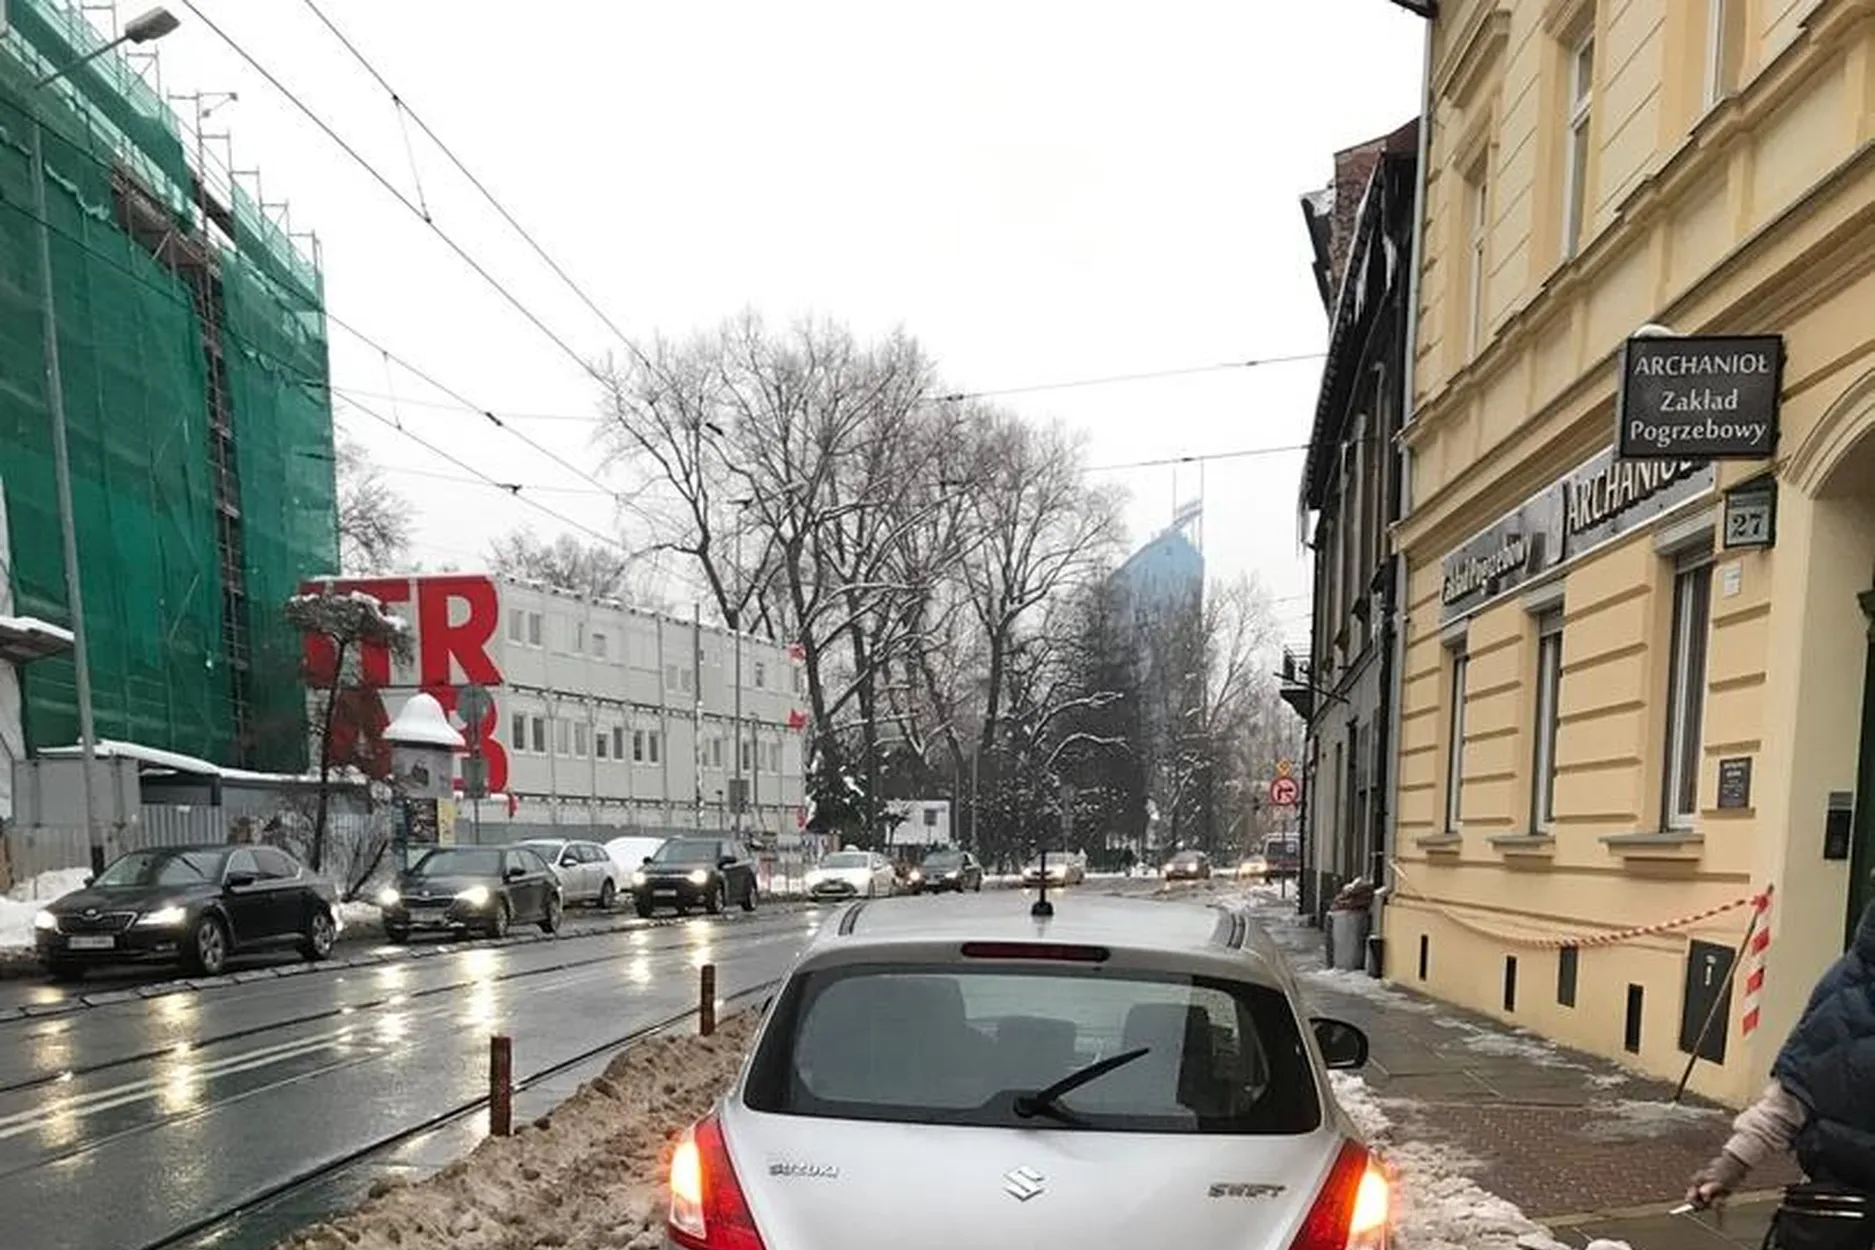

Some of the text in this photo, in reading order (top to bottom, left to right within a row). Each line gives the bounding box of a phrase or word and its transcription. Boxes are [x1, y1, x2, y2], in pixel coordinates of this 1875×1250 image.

[1634, 353, 1769, 376] ARCHANIOŁ
[1660, 387, 1739, 412] Zakład
[1630, 417, 1767, 448] Pogrzebowy
[1731, 512, 1763, 538] 27
